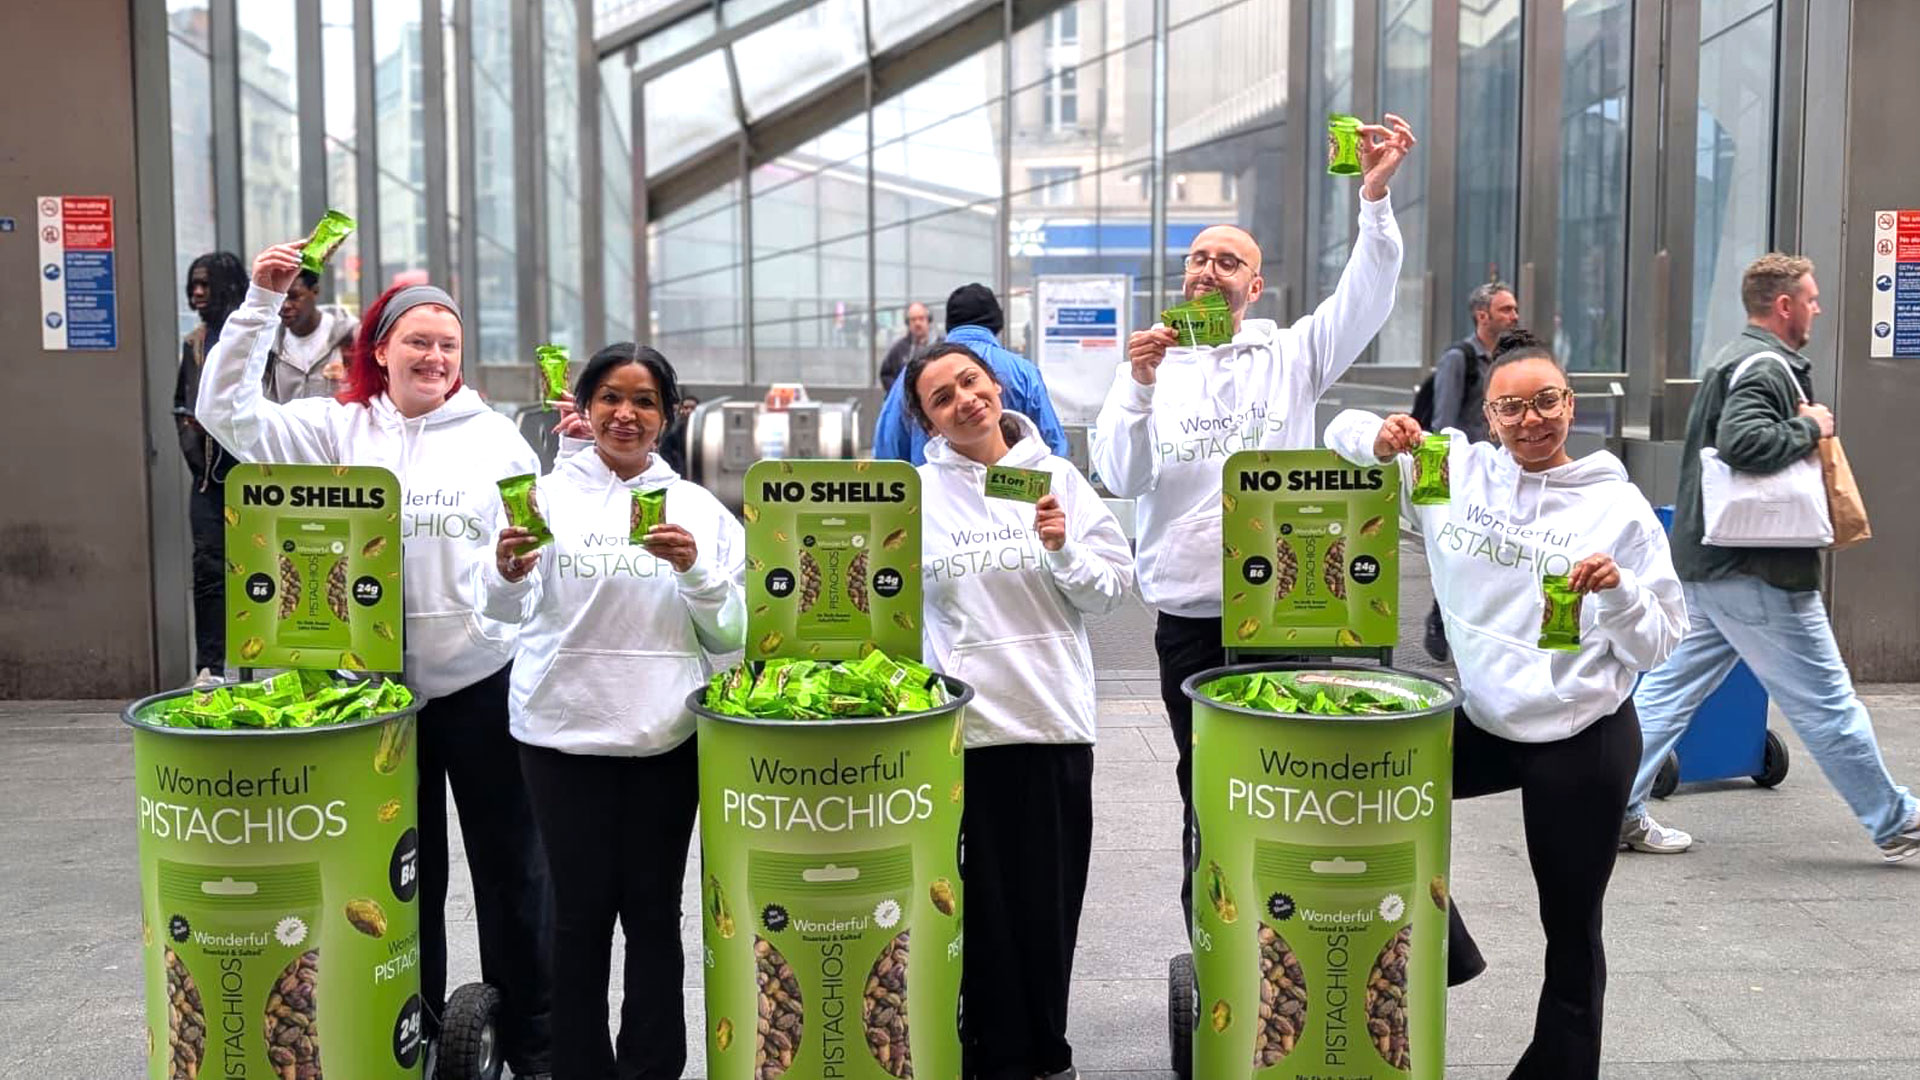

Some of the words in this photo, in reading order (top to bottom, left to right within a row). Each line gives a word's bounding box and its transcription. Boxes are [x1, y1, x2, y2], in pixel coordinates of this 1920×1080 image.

[1160, 411, 1283, 463] PISTACHIS
[763, 481, 805, 503] NO
[810, 481, 905, 503] SHELLS
[1240, 470, 1282, 492] NO
[1287, 469, 1384, 491] SHELLS
[243, 484, 285, 506] NO
[290, 486, 385, 509] SHELLS
[877, 574, 899, 586] 24g
[1354, 561, 1376, 573] 24g
[357, 583, 379, 595] 24g
[772, 581, 787, 591] B6
[750, 751, 904, 785] Wonderful
[1260, 748, 1412, 780] Wonderful
[156, 764, 309, 797] Wonderful
[724, 783, 933, 832] PISTACHIOS
[1229, 778, 1434, 825] PISTACHIOS
[140, 796, 348, 845] PISTACHIOS
[401, 859, 416, 887] B6
[793, 916, 868, 932] Wonderful
[1300, 908, 1374, 923] Wonderful
[194, 931, 268, 946] Wonderful
[822, 943, 845, 1078] PISTACHIOS
[1325, 934, 1349, 1065] PISTACHIOS
